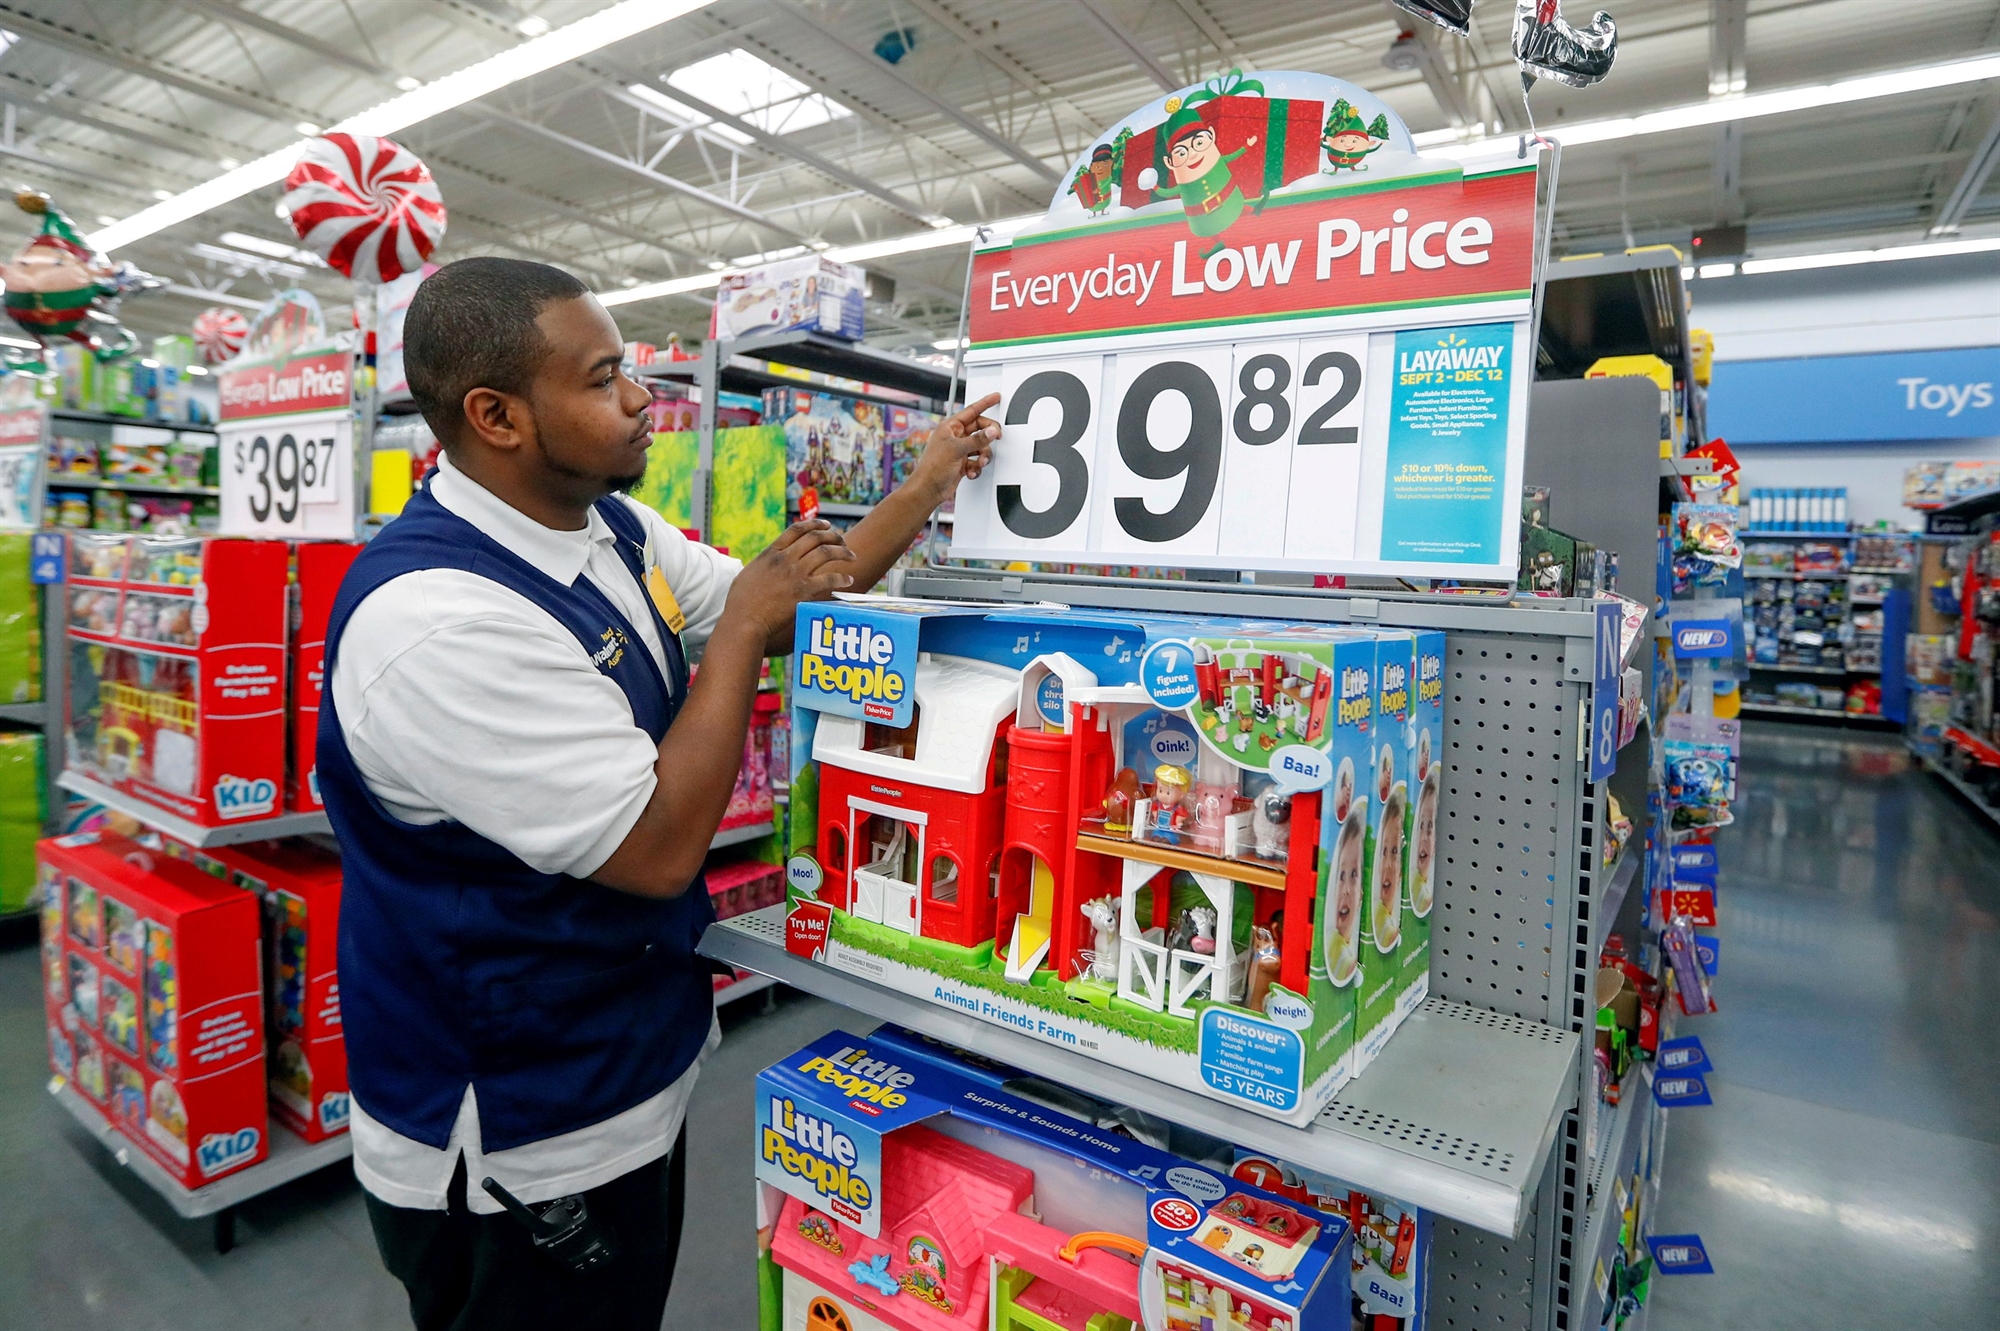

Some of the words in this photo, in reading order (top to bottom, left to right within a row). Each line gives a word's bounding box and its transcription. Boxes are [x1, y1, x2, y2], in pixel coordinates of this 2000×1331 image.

[990, 253, 1160, 313] Everyday
[1171, 239, 1302, 298] Low
[1316, 208, 1494, 281] Price
[1400, 346, 1504, 372] LAYAWAY
[268, 373, 301, 403] Low
[302, 364, 346, 399] Price
[1400, 372, 1432, 385] SEPT
[1435, 372, 1444, 383] 2
[1455, 370, 1483, 382] DEC
[1487, 369, 1503, 380] 12
[1451, 388, 1486, 396] Electronics,
[1897, 376, 1995, 417] Toys
[1409, 406, 1438, 414] Furniture,
[1469, 412, 1497, 420] Sporting
[1438, 429, 1461, 437] Jewelry
[1449, 421, 1485, 430] Appliances,
[1394, 474, 1444, 483] whichever
[1445, 474, 1454, 482] is
[1455, 474, 1496, 484] greater.
[1402, 464, 1419, 474] $10
[1434, 463, 1454, 472] 10%
[1455, 463, 1488, 473] down,
[35, 535, 62, 557] N
[36, 561, 58, 579] 4
[810, 616, 894, 666] Little
[1601, 615, 1619, 680] N
[1682, 631, 1714, 647] NEW
[1161, 650, 1178, 673] 7
[1421, 653, 1440, 679] Little
[801, 652, 904, 702] People
[1156, 674, 1190, 687] figures
[1342, 666, 1369, 698] Little
[1383, 661, 1405, 691] Little
[1153, 684, 1195, 697] included!
[1419, 677, 1442, 703] People
[1043, 700, 1060, 709] silo
[1338, 694, 1371, 725] People
[1380, 687, 1407, 715] People
[1156, 740, 1190, 753] Oink!
[1600, 708, 1613, 765] 8
[1283, 756, 1320, 778] Baa!
[218, 781, 273, 808] KID
[1679, 852, 1703, 866] NEW
[793, 868, 813, 879] Moo!
[790, 917, 806, 932] Try
[807, 918, 824, 931] Me!
[794, 931, 808, 940] Open
[934, 986, 979, 1012] Animal
[983, 1002, 1035, 1031] Friends
[1038, 1020, 1077, 1045] Farm
[1274, 1005, 1307, 1019] Neigh!
[1217, 1016, 1286, 1047] Discover:
[1221, 1033, 1246, 1046] Animals
[1254, 1042, 1277, 1054] animal
[1221, 1041, 1243, 1052] sounds
[827, 1046, 916, 1089] Little
[1220, 1049, 1246, 1062] Familiar
[1247, 1057, 1264, 1068] farm
[1264, 1064, 1284, 1075] songs
[1664, 1049, 1689, 1067] NEW
[1220, 1059, 1250, 1075] Matching
[1250, 1068, 1265, 1079] play
[798, 1056, 907, 1109] People
[1211, 1071, 1233, 1089] 1-5
[1236, 1078, 1286, 1106] YEARS
[1661, 1080, 1688, 1095] NEW
[772, 1096, 856, 1167] Little
[964, 1091, 1017, 1115] Surprise
[1017, 1110, 1028, 1119] &
[1029, 1115, 1079, 1138] Sounds
[1079, 1133, 1122, 1154] Home
[200, 1131, 258, 1168] KID
[763, 1127, 871, 1208] People
[1250, 1166, 1266, 1187] 7
[1174, 1172, 1193, 1182] What
[1194, 1179, 1220, 1190] should
[1192, 1184, 1219, 1195] today?
[1164, 1202, 1193, 1221] 50+
[1662, 1247, 1689, 1262] NEW
[1368, 1280, 1405, 1309] Baa!
